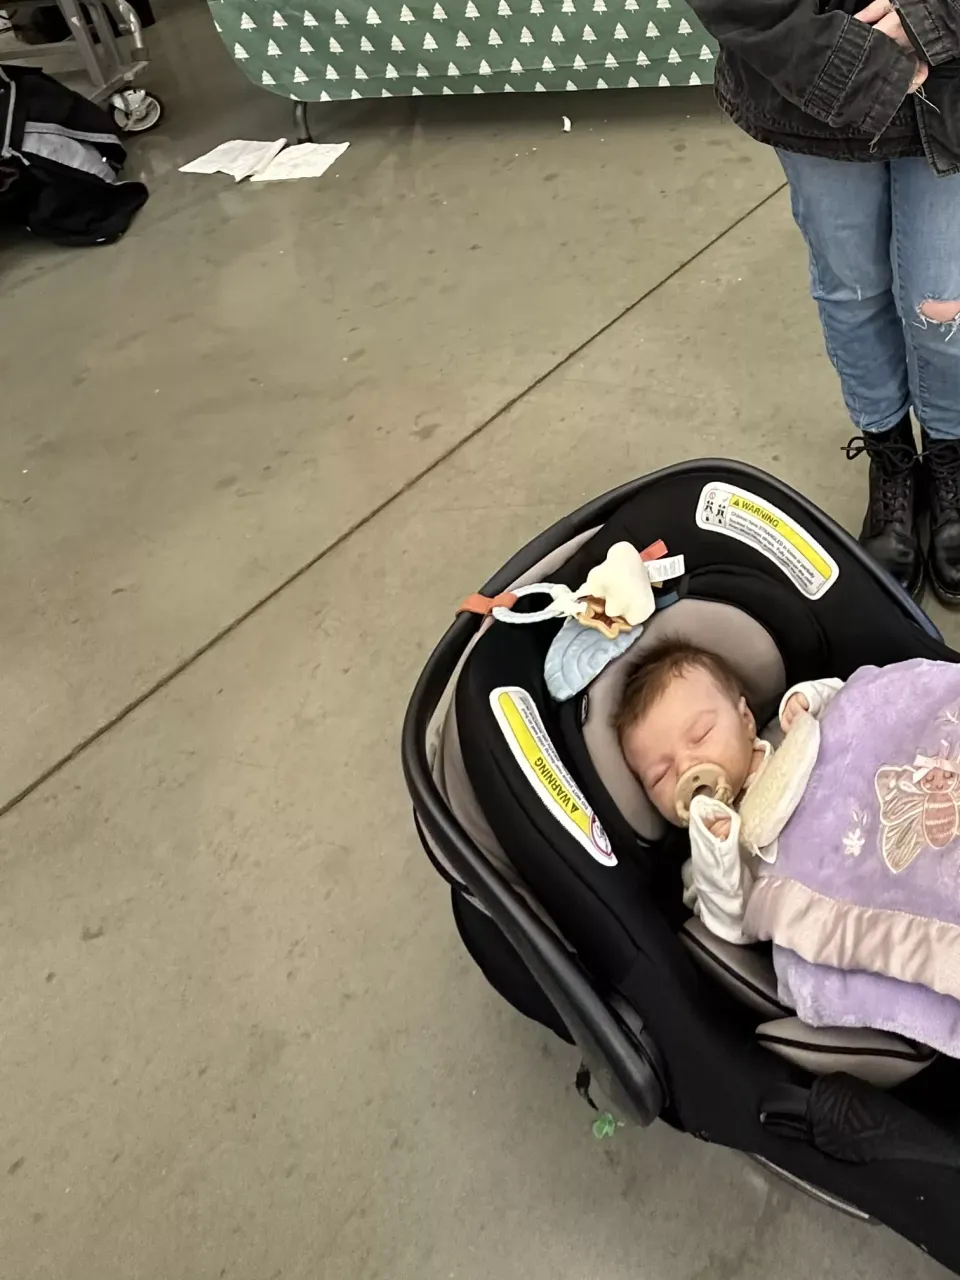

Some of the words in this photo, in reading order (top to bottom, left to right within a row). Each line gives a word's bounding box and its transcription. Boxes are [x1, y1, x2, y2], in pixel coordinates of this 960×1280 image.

[741, 500, 780, 528] WARNING
[758, 525, 784, 547] STRANGLED
[534, 757, 570, 806] WARNING
